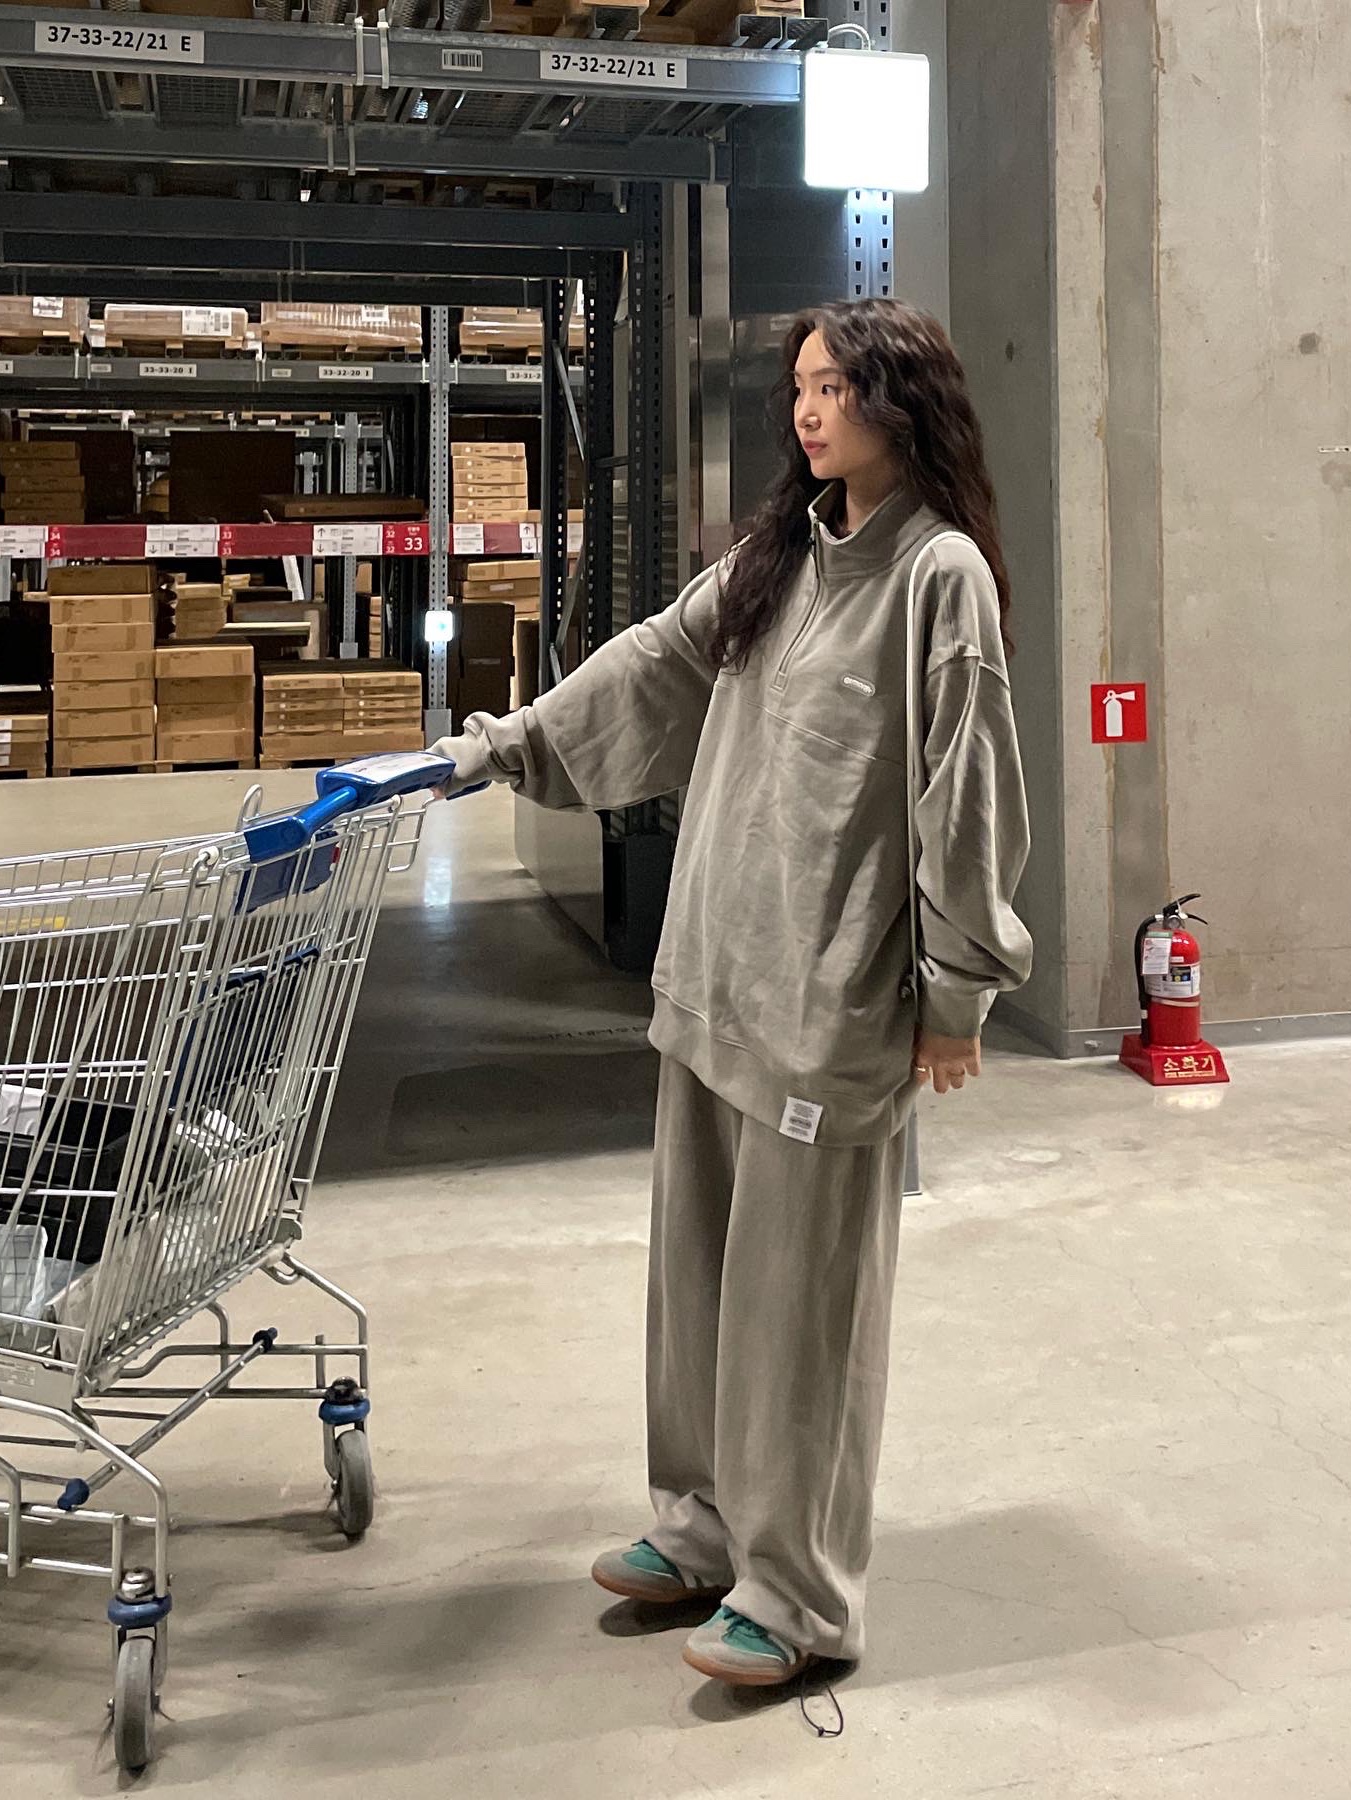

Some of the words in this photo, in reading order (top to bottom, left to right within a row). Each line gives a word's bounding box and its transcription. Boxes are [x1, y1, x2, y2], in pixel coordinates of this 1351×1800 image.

[48, 26, 168, 51] 37-33-22/21
[181, 36, 191, 52] E
[551, 54, 656, 78] 37-32-22/21
[666, 62, 675, 78] E
[50, 531, 60, 540] 34
[404, 537, 423, 551] 33
[50, 548, 60, 557] 34
[1163, 1054, 1216, 1074] 소화기
